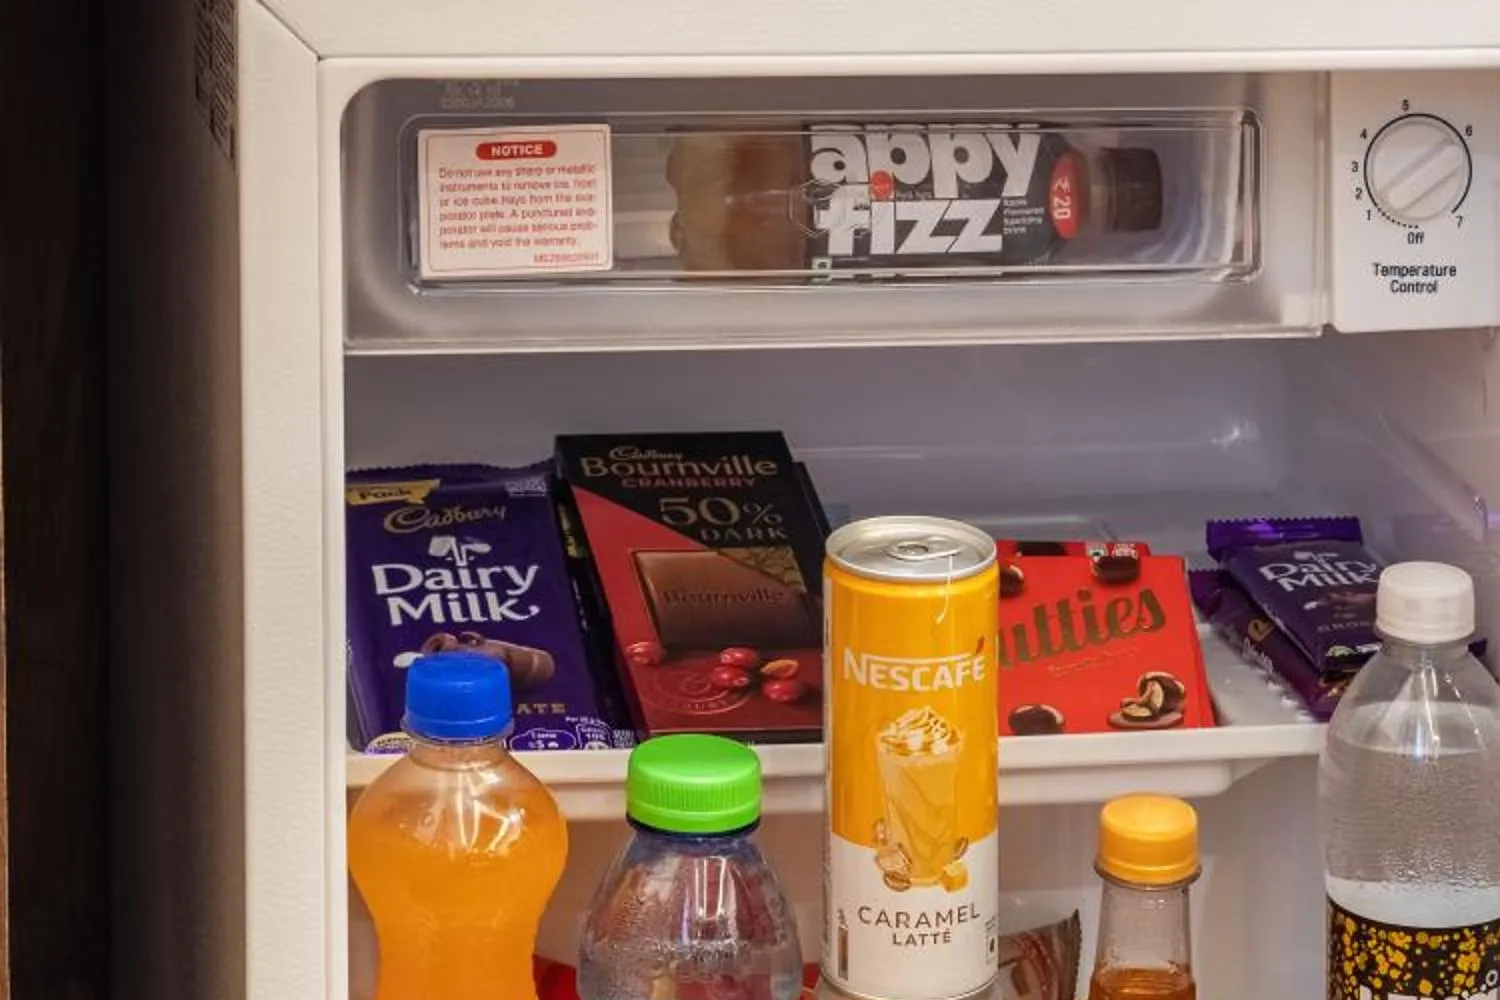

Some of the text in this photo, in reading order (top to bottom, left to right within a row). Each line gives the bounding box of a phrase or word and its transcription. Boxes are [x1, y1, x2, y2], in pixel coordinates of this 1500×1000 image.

[491, 143, 543, 157] NOTICE
[810, 123, 1041, 199] appy
[1351, 161, 1359, 172] 3
[1355, 188, 1362, 199] 2
[814, 178, 1003, 255] fizz
[1407, 232, 1424, 244] Off
[1373, 262, 1457, 278] Temperature
[1390, 279, 1438, 294] Control
[580, 455, 778, 478] Bournville
[383, 504, 508, 534] Cadbury
[659, 497, 783, 527] 50%
[700, 527, 788, 541] DARK
[371, 563, 540, 597] Dairy
[1259, 560, 1377, 581] Dairy
[1277, 572, 1379, 592] Milk
[387, 592, 541, 627] Milk
[997, 587, 1166, 670] utties
[843, 636, 986, 692] NESCAFÉ
[857, 902, 981, 929] CARAMEL
